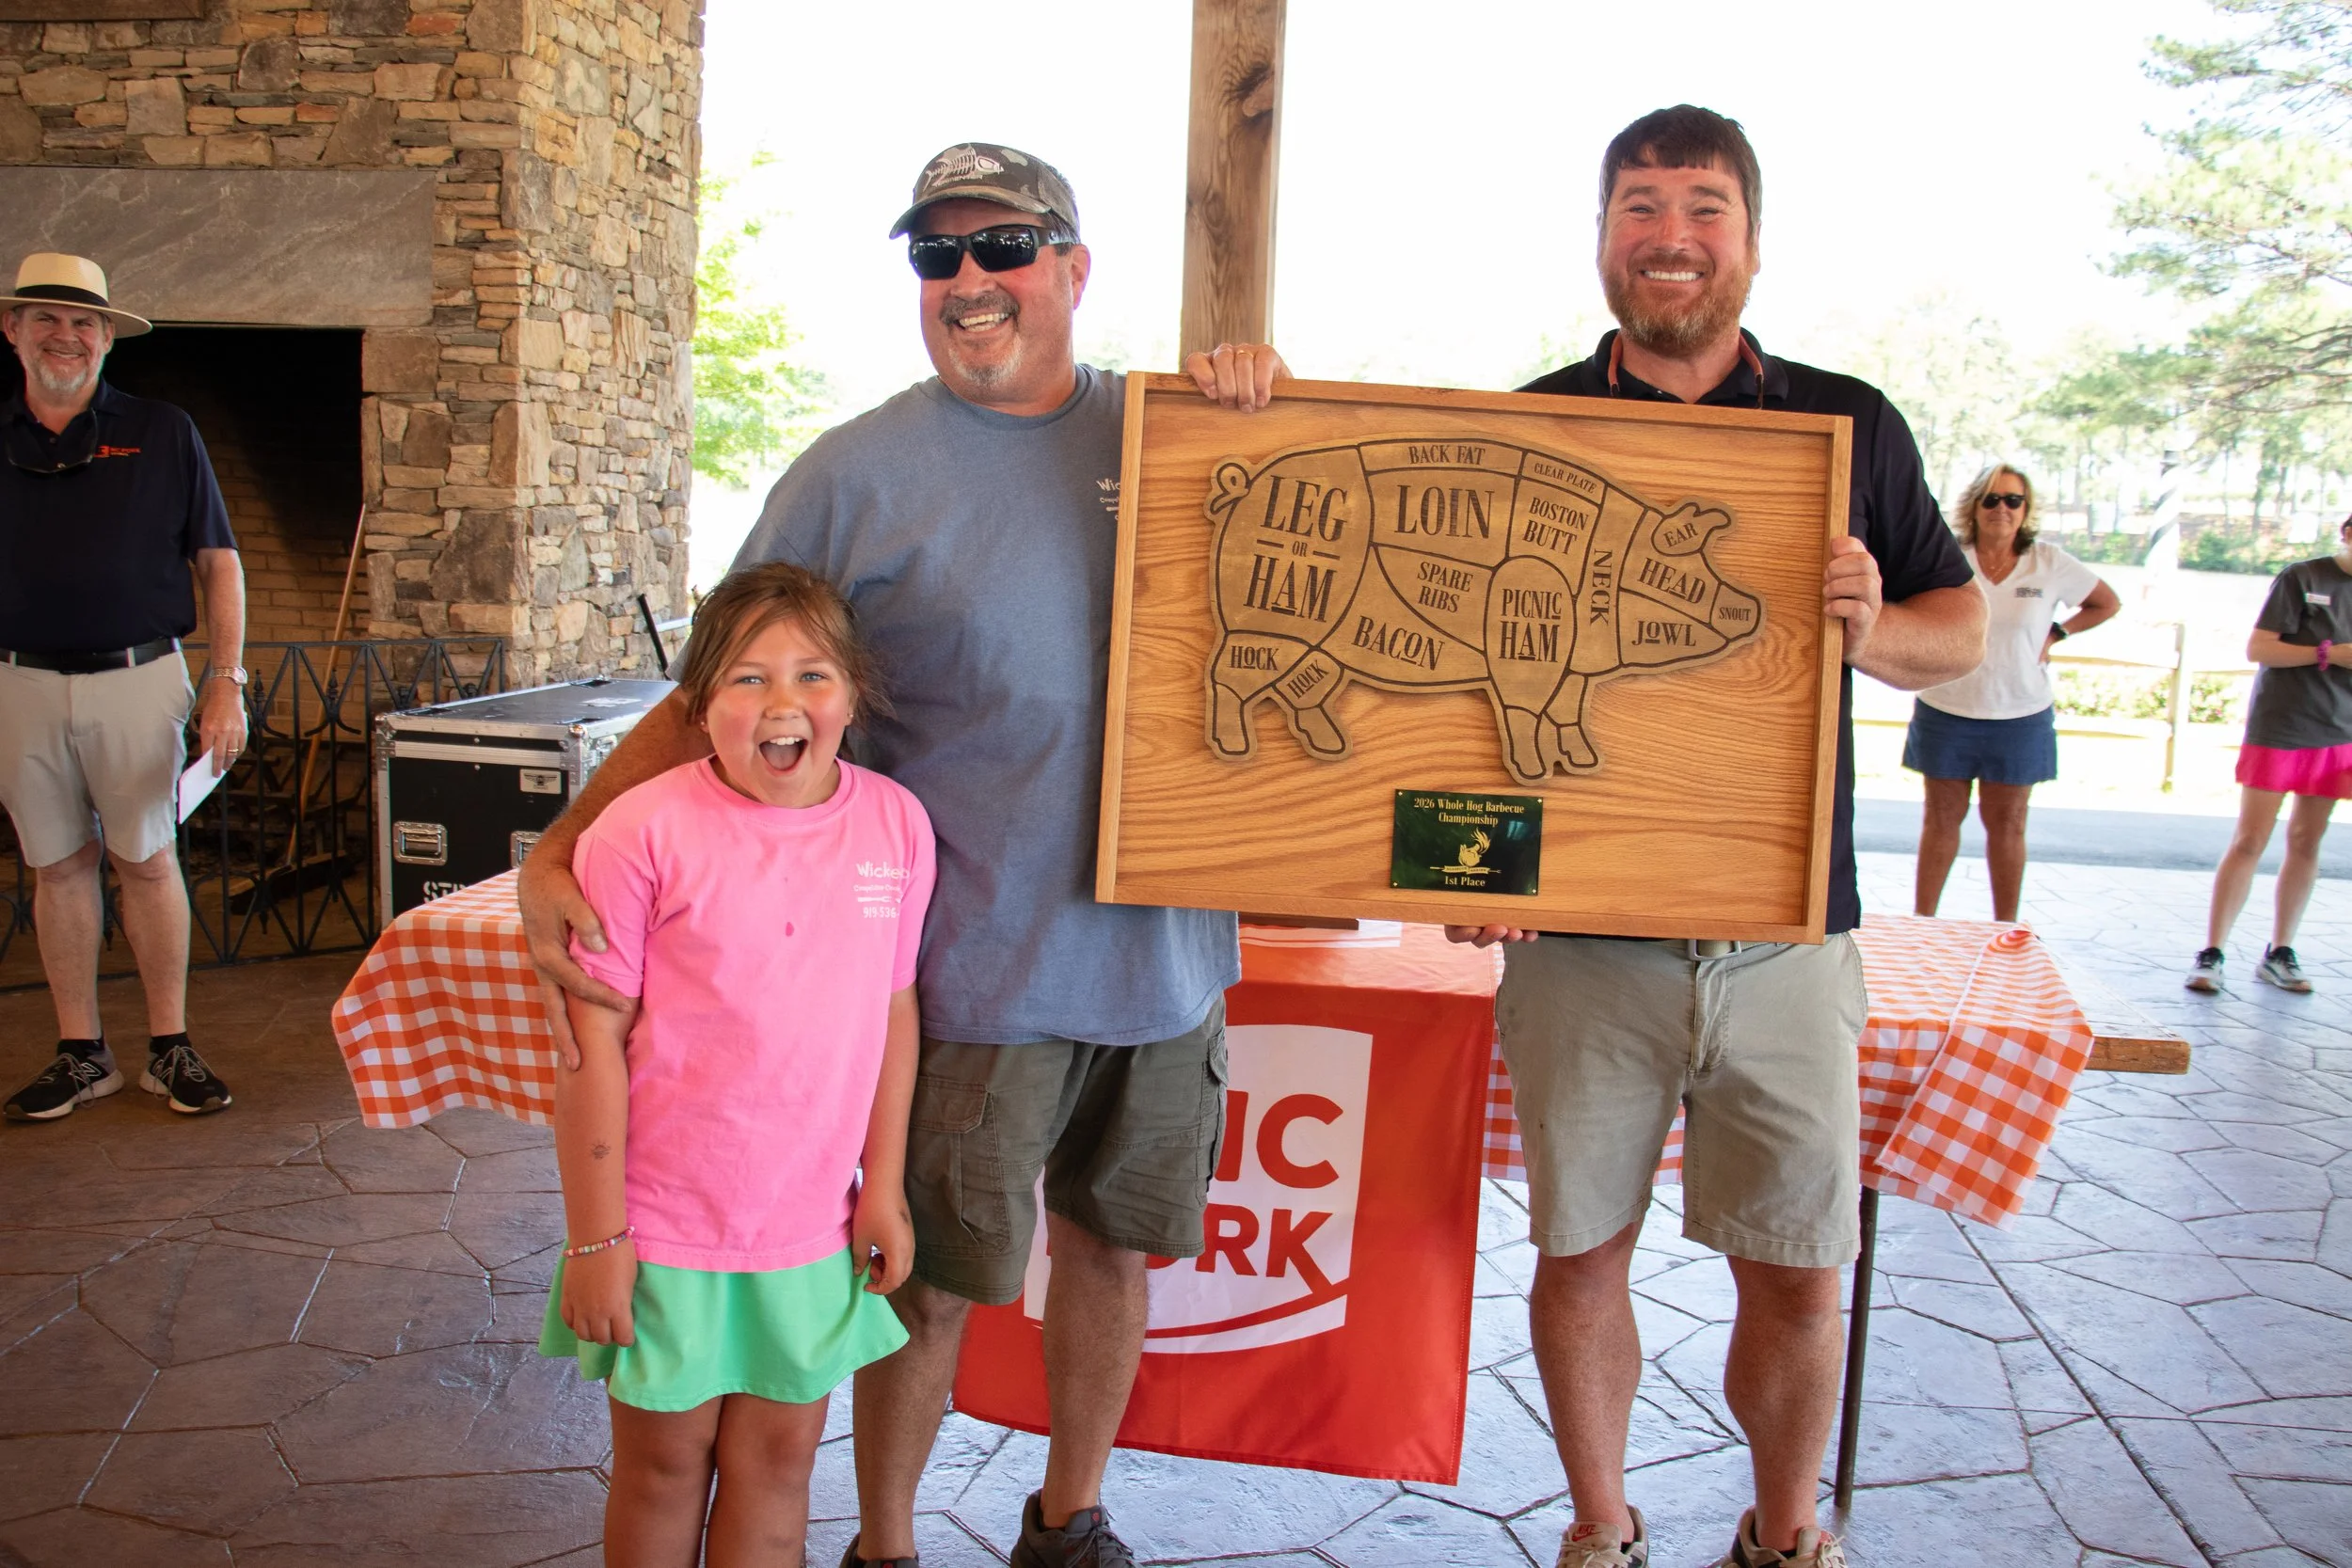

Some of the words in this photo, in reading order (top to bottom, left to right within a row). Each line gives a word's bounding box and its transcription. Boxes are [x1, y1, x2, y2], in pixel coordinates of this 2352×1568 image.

[1408, 444, 1452, 465] BACK
[1455, 445, 1486, 466] FAT
[1534, 463, 1564, 482] CLEAR
[1566, 471, 1597, 494] PLATE
[1260, 475, 1348, 542] LEG
[1394, 484, 1495, 539] LOIN
[1529, 497, 1589, 531] BOSTON
[1292, 541, 1309, 557] OR
[1522, 519, 1577, 555] BUTT
[1663, 522, 1698, 547] EAR
[1243, 553, 1338, 623] HAM
[1417, 562, 1473, 593] SPARE
[1590, 548, 1613, 626] NECK
[1637, 557, 1706, 604] HEAD
[1418, 585, 1460, 613] RIBS
[1501, 588, 1562, 620] PICNIC
[1718, 606, 1751, 622] SNOUT
[1351, 615, 1445, 671] BACON
[1499, 621, 1560, 662] HAM
[1631, 620, 1696, 646] JOWL
[1229, 645, 1279, 671] HOCK
[1286, 659, 1330, 700] HOCK
[1414, 798, 1435, 809] 2026
[1438, 799, 1464, 811] Whole
[1467, 800, 1483, 814] Hog
[1486, 801, 1525, 814] Barbecue
[1438, 812, 1499, 828] Championship
[1444, 876, 1457, 886] 1st
[1461, 877, 1486, 887] Place
[1144, 1203, 1334, 1293] RK
